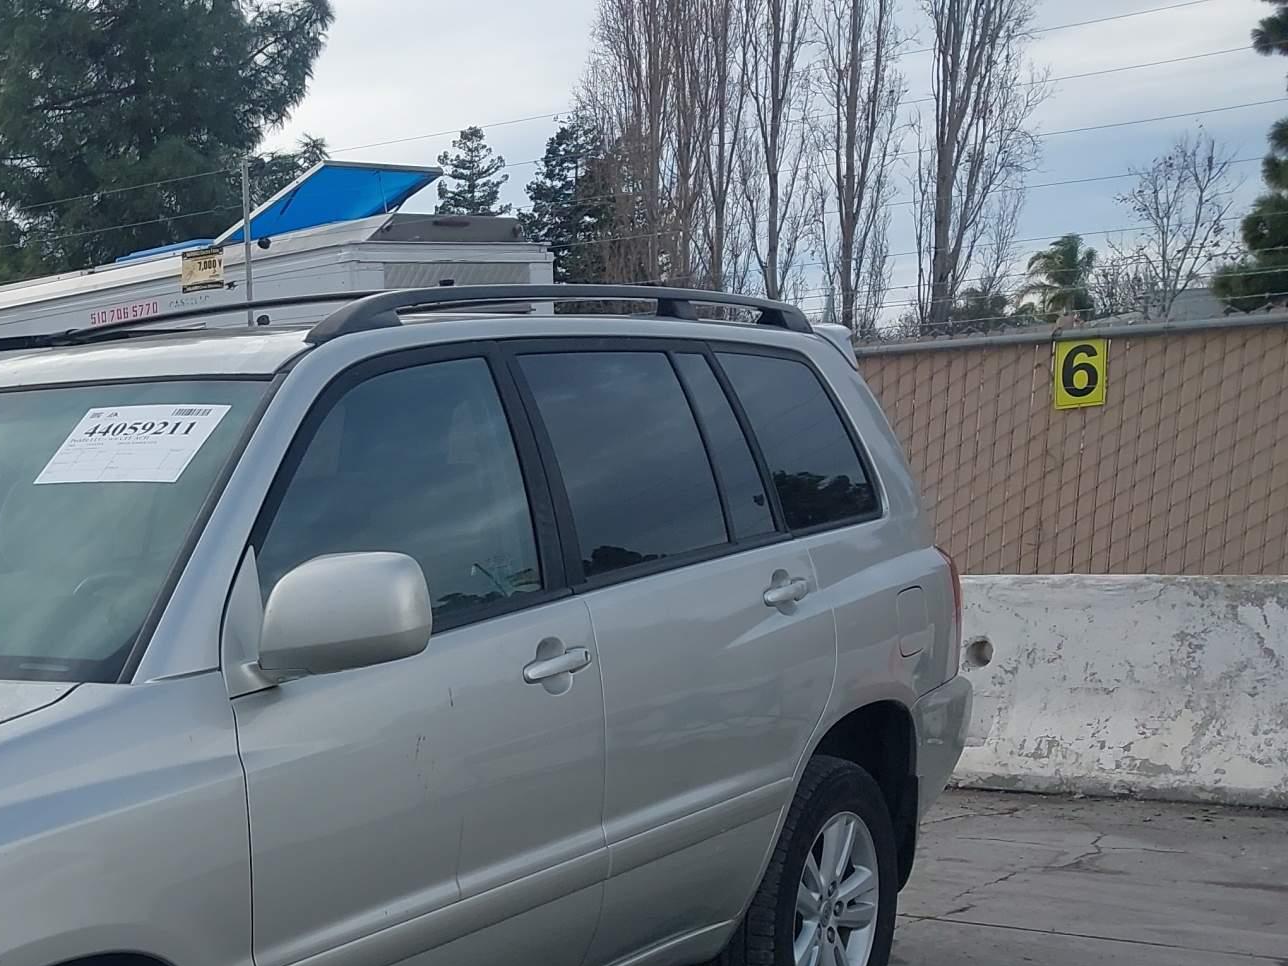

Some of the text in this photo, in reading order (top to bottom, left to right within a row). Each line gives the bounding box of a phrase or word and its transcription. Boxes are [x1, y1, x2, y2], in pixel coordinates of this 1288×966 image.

[197, 259, 216, 271] 7,000
[90, 311, 107, 325] 510
[110, 308, 129, 322] 706
[132, 301, 158, 318] 5770
[1062, 344, 1098, 397] 6
[84, 420, 198, 438] 44059211
